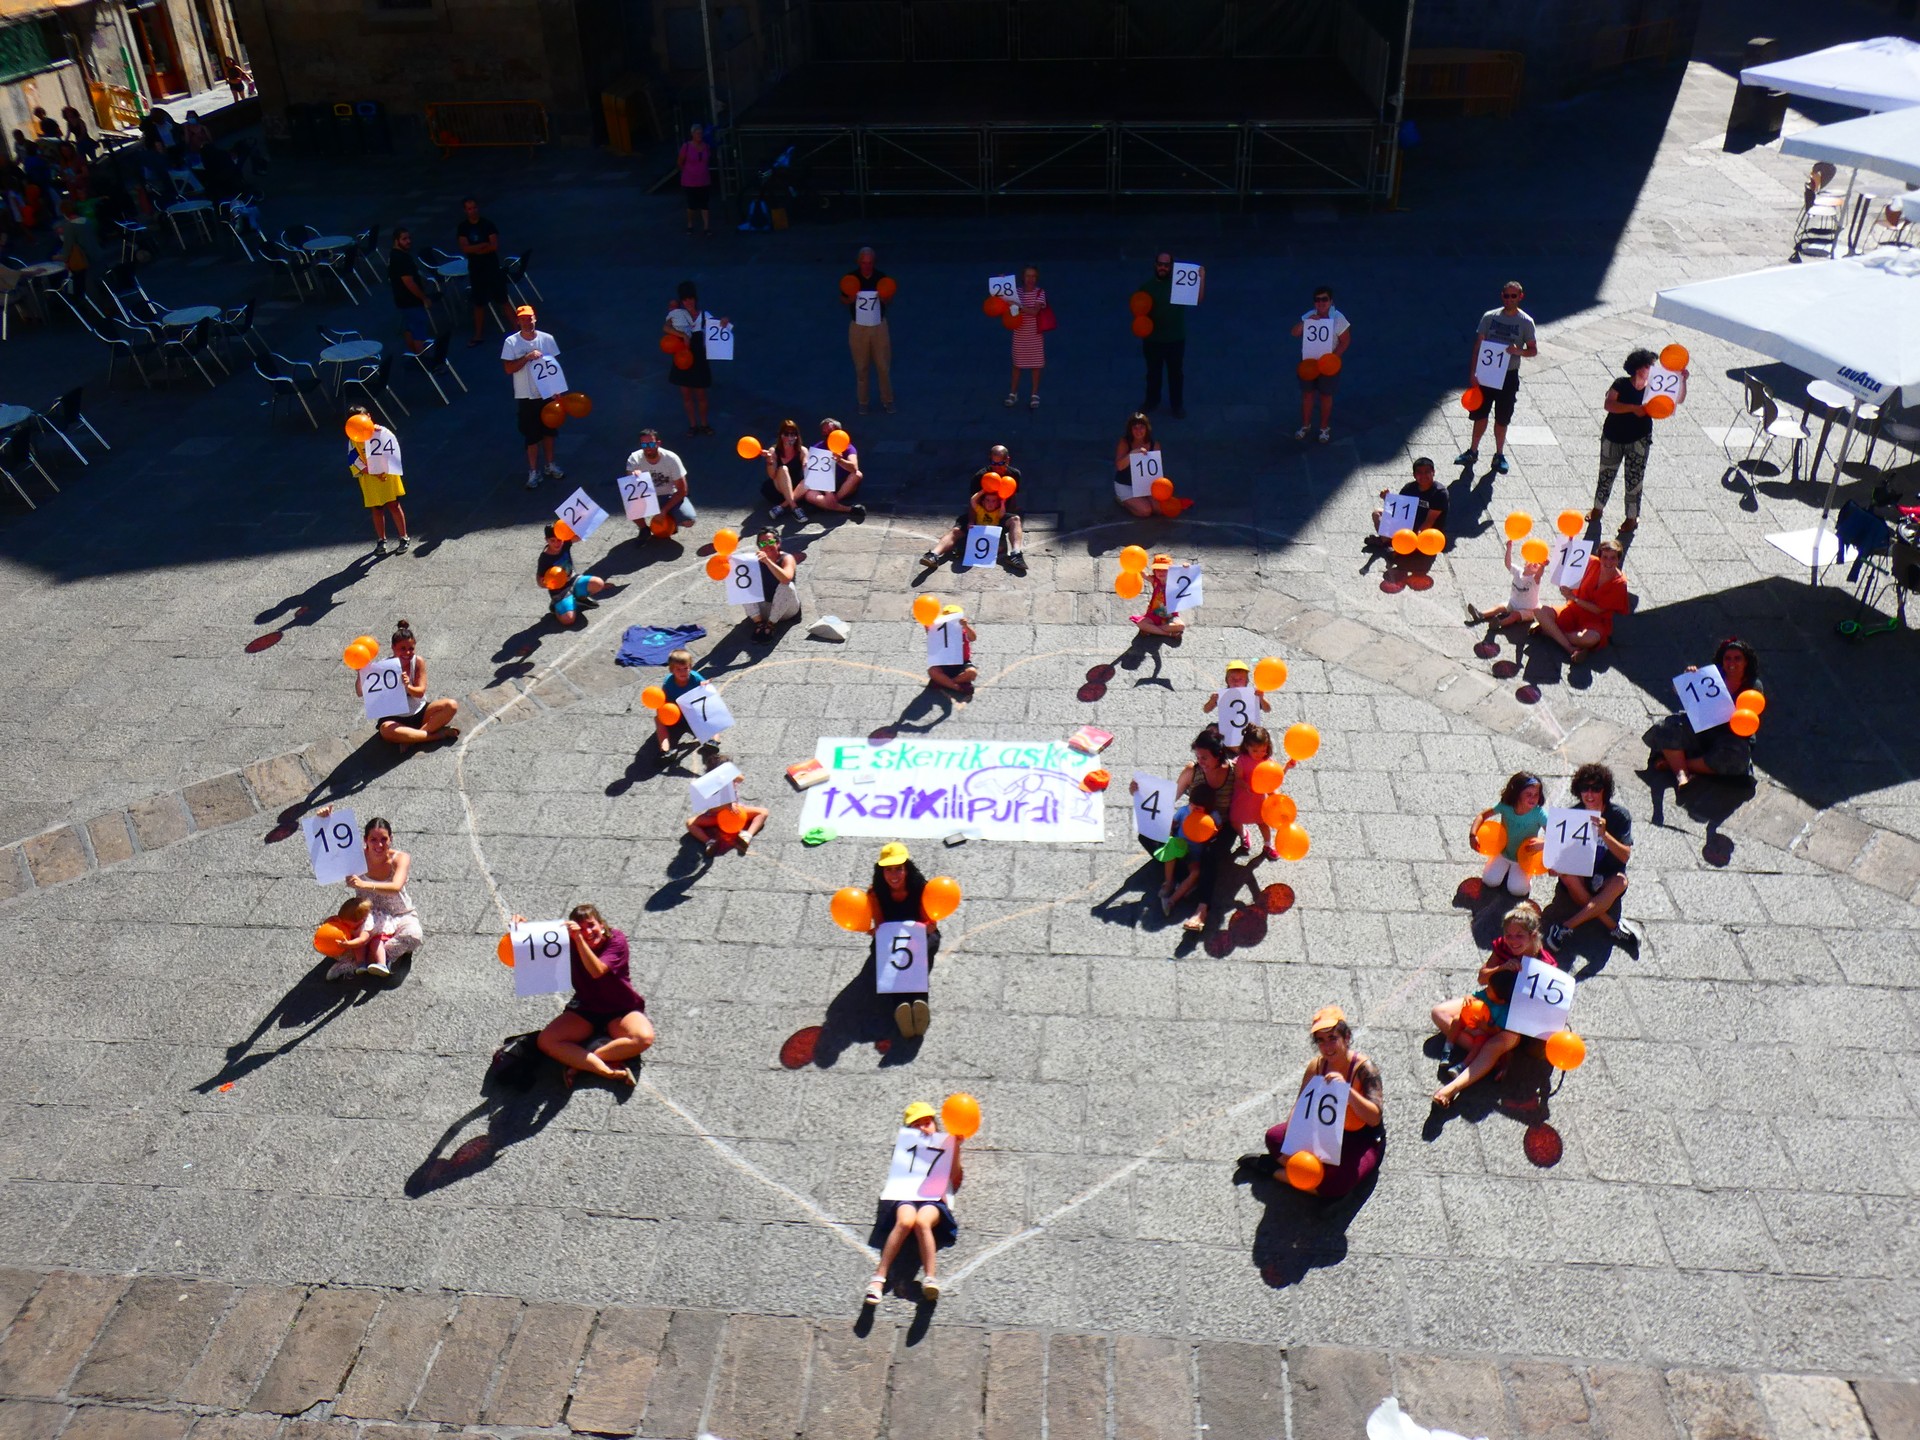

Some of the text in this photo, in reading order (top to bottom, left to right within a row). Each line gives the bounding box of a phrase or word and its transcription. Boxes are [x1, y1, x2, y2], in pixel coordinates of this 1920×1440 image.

[1176, 270, 1198, 286] 29
[993, 284, 1013, 297] 28
[858, 296, 877, 311] 27
[709, 324, 730, 341] 26
[1307, 325, 1329, 342] 30
[1482, 349, 1503, 368] 31
[534, 361, 558, 380] 25
[1837, 366, 1883, 393] LAVAZZA
[1649, 375, 1676, 394] 32
[370, 438, 395, 456] 24
[808, 456, 832, 472] 23
[1136, 459, 1158, 476] 10
[624, 481, 651, 502] 22
[564, 498, 584, 525] 21
[1390, 502, 1410, 519] 11
[975, 538, 989, 559] 9
[1560, 547, 1585, 567] 12
[736, 564, 752, 589] 8
[1175, 576, 1191, 599] 2
[937, 622, 948, 648] 1
[367, 670, 398, 693] 20
[1686, 677, 1720, 702] 13
[690, 696, 707, 725] 7
[1230, 700, 1248, 728] 3
[832, 743, 989, 770] Eskerrik
[1141, 791, 1160, 820] 4
[315, 823, 353, 852] 19
[1556, 820, 1590, 846] 14
[522, 931, 562, 961] 18
[891, 936, 913, 971] 5
[1526, 972, 1563, 1006] 15
[1305, 1089, 1338, 1126] 16
[907, 1145, 946, 1177] 17
